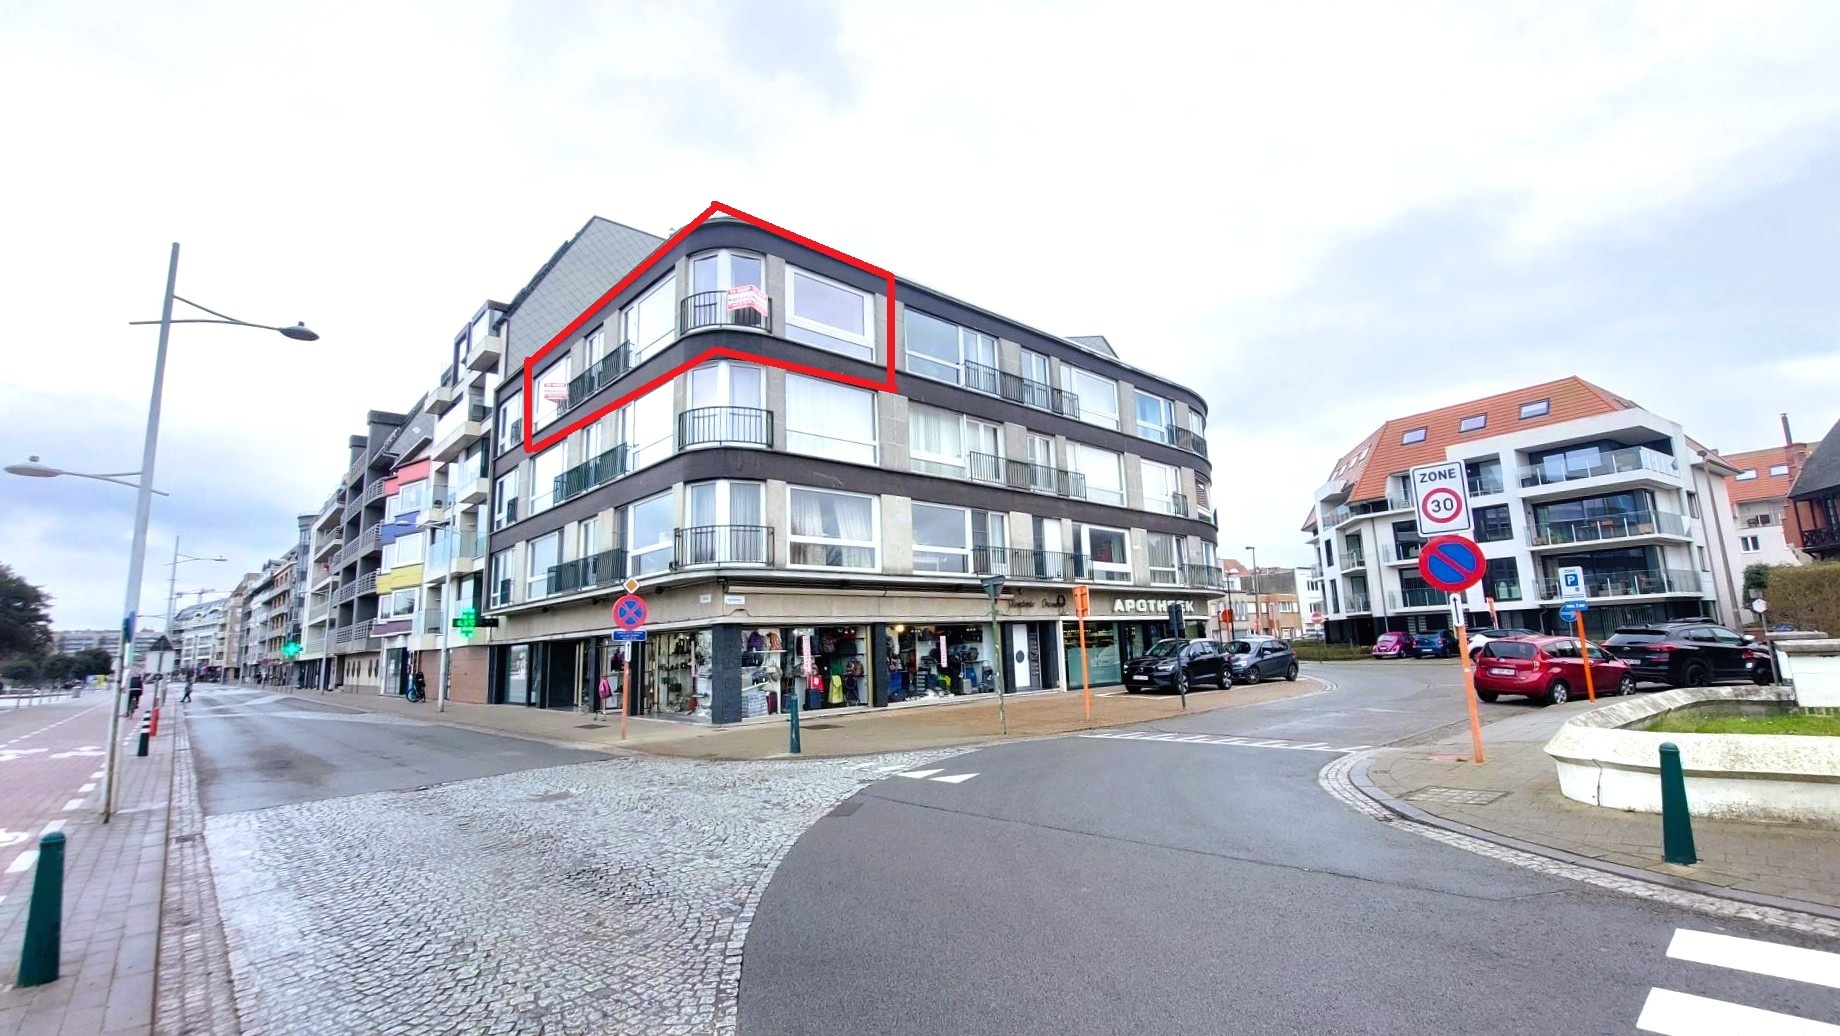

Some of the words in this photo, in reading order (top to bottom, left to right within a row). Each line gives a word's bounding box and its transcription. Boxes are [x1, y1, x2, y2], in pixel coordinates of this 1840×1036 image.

[1419, 468, 1457, 483] ZONE
[1431, 498, 1454, 512] 30
[1567, 576, 1575, 585] P
